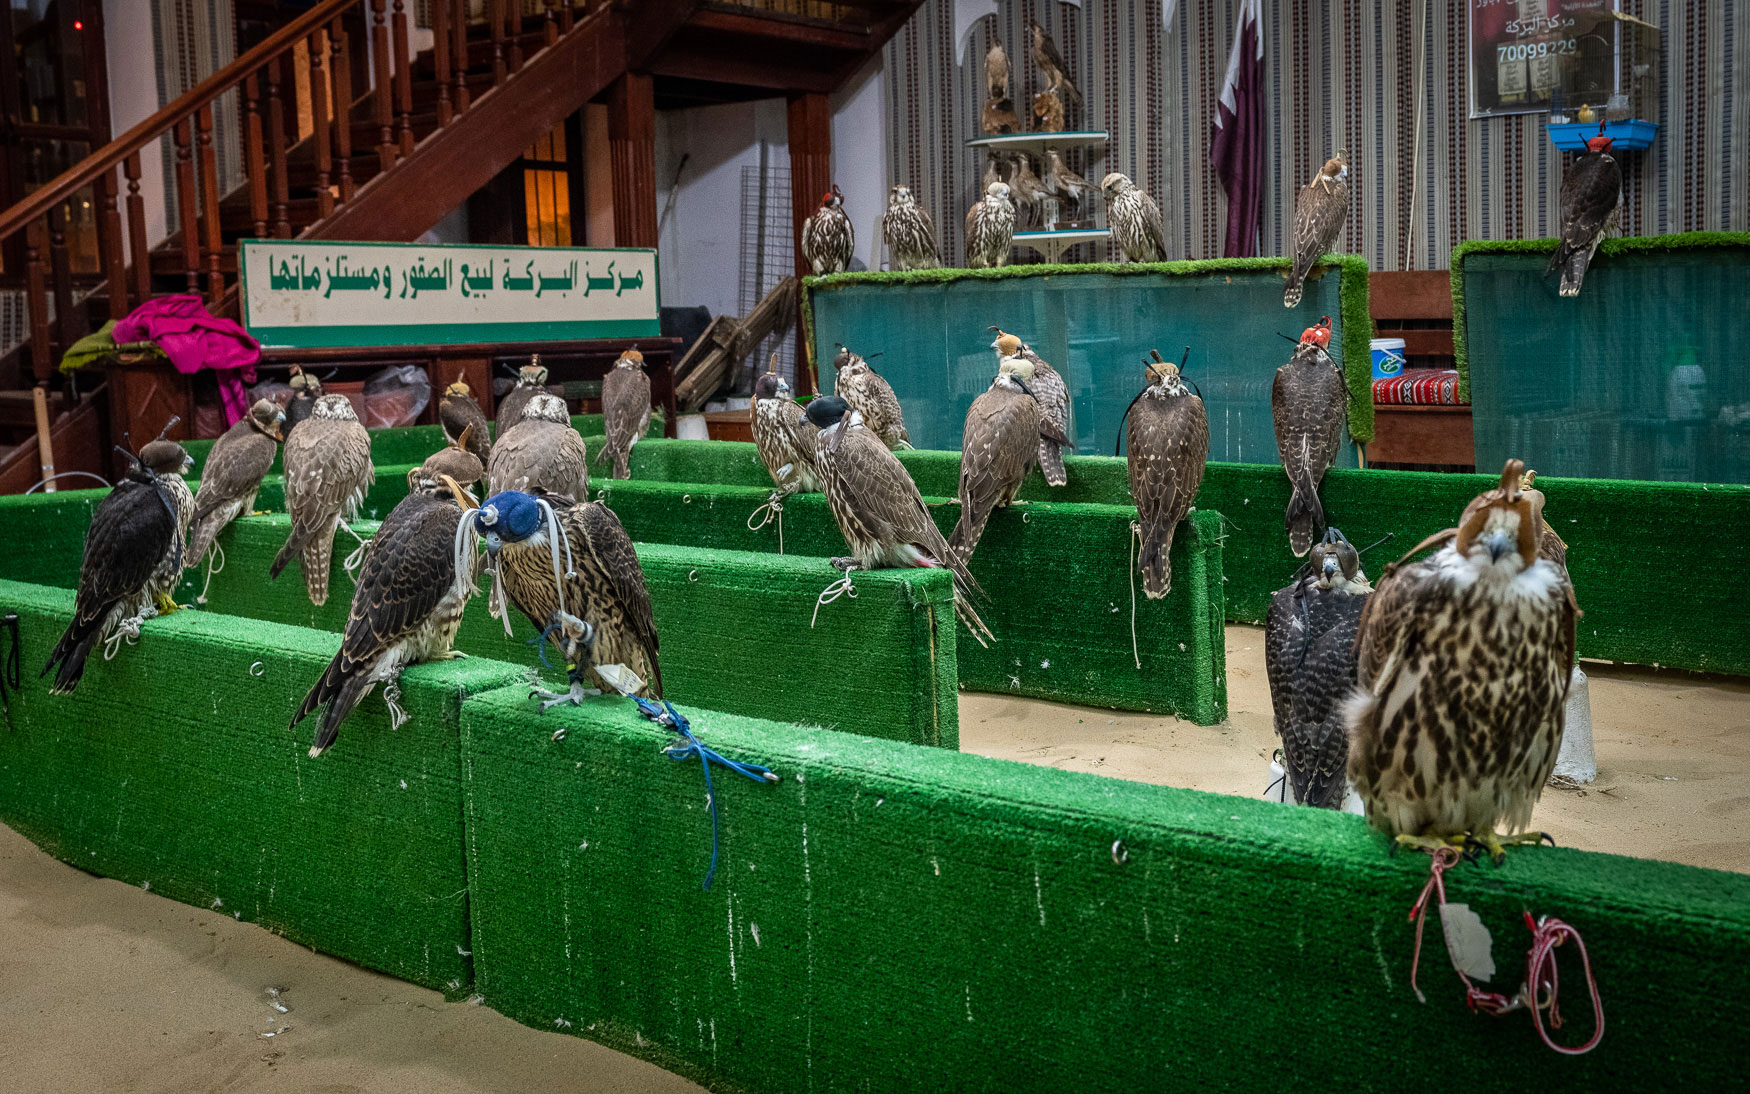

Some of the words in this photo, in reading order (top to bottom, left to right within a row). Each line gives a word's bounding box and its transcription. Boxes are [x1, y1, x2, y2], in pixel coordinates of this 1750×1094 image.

[1505, 16, 1541, 36] البركة
[1497, 39, 1577, 62] 70099229
[269, 253, 392, 300] ومستلزماتها
[399, 256, 453, 300] الصقور
[460, 258, 494, 299] لبيع
[502, 258, 579, 299] البركة
[583, 260, 644, 299] مركز
